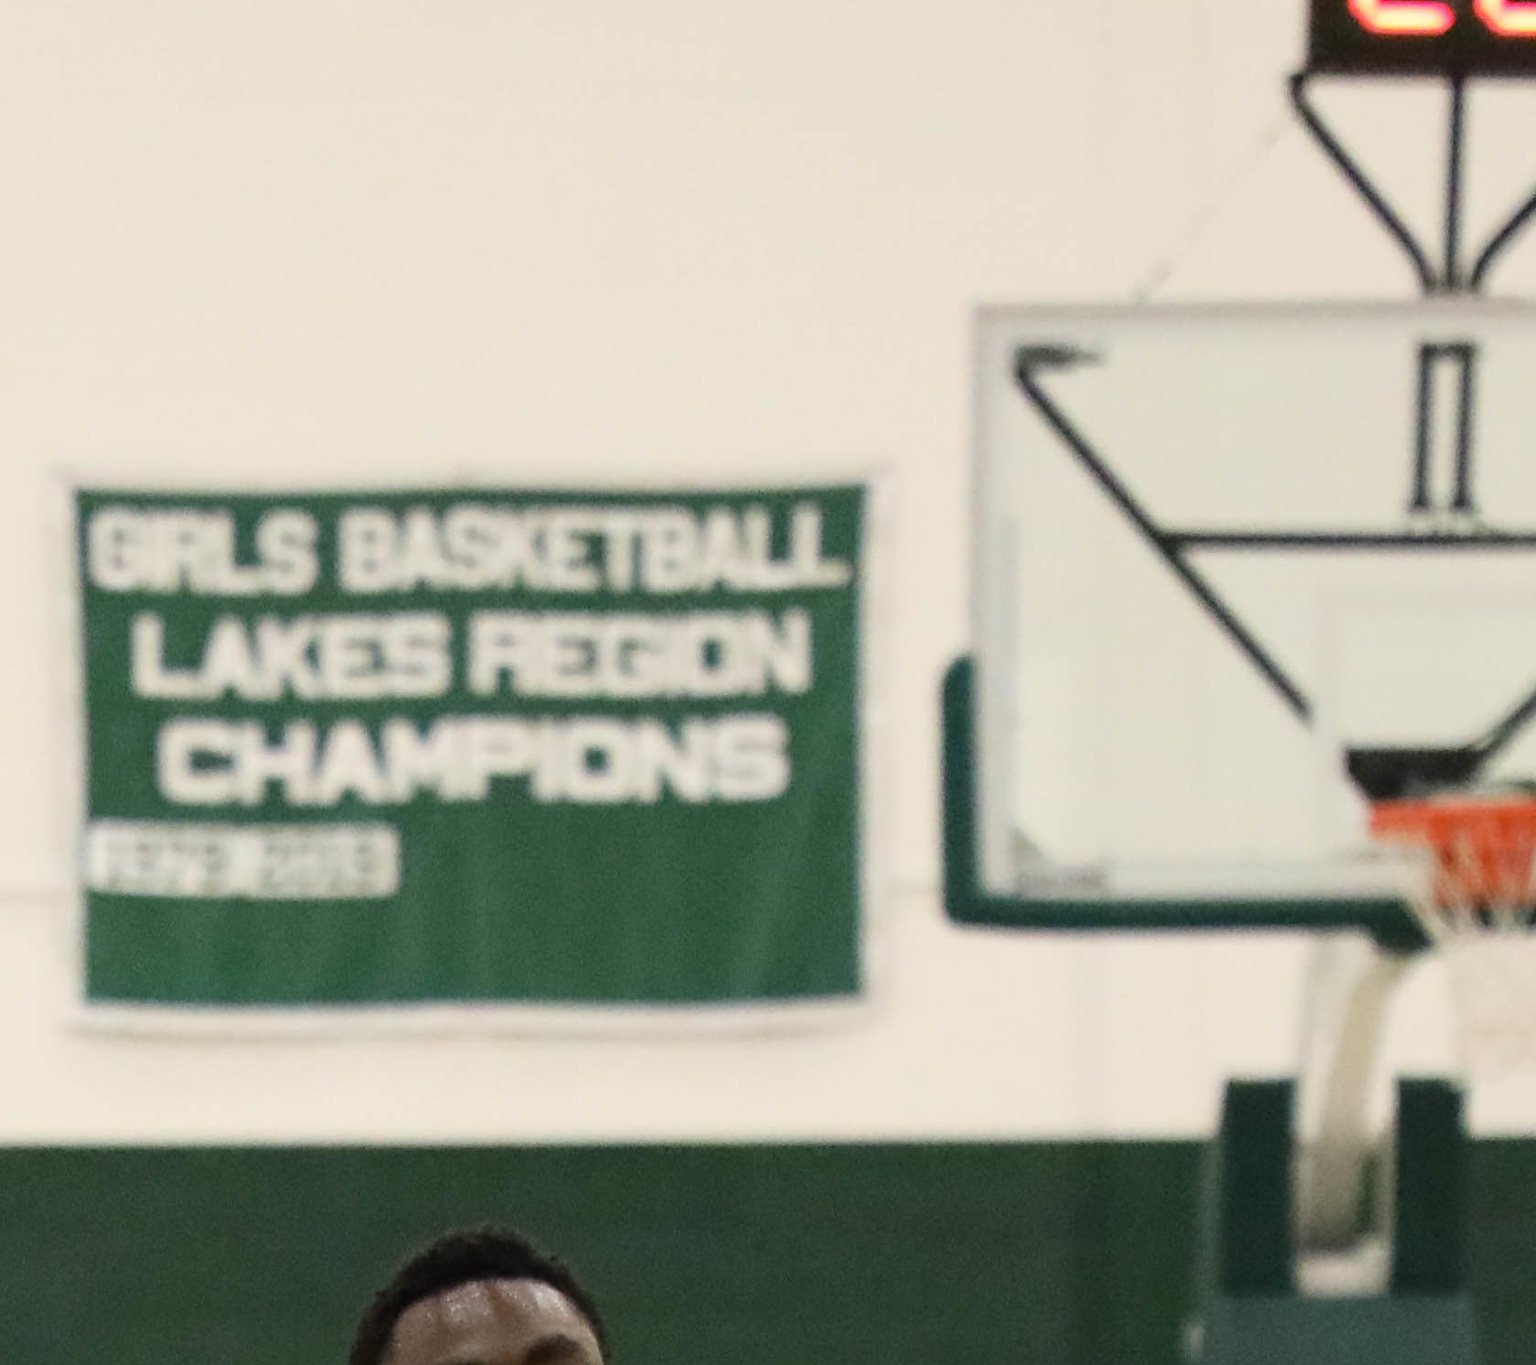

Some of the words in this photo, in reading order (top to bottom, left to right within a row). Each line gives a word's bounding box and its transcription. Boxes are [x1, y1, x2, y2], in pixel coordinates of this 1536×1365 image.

[88, 505, 320, 596] GIRLS
[337, 504, 852, 595] BASKETBALL
[132, 610, 451, 700] LAKES
[467, 609, 812, 699] REGION
[156, 713, 791, 804] CHAMPIONS
